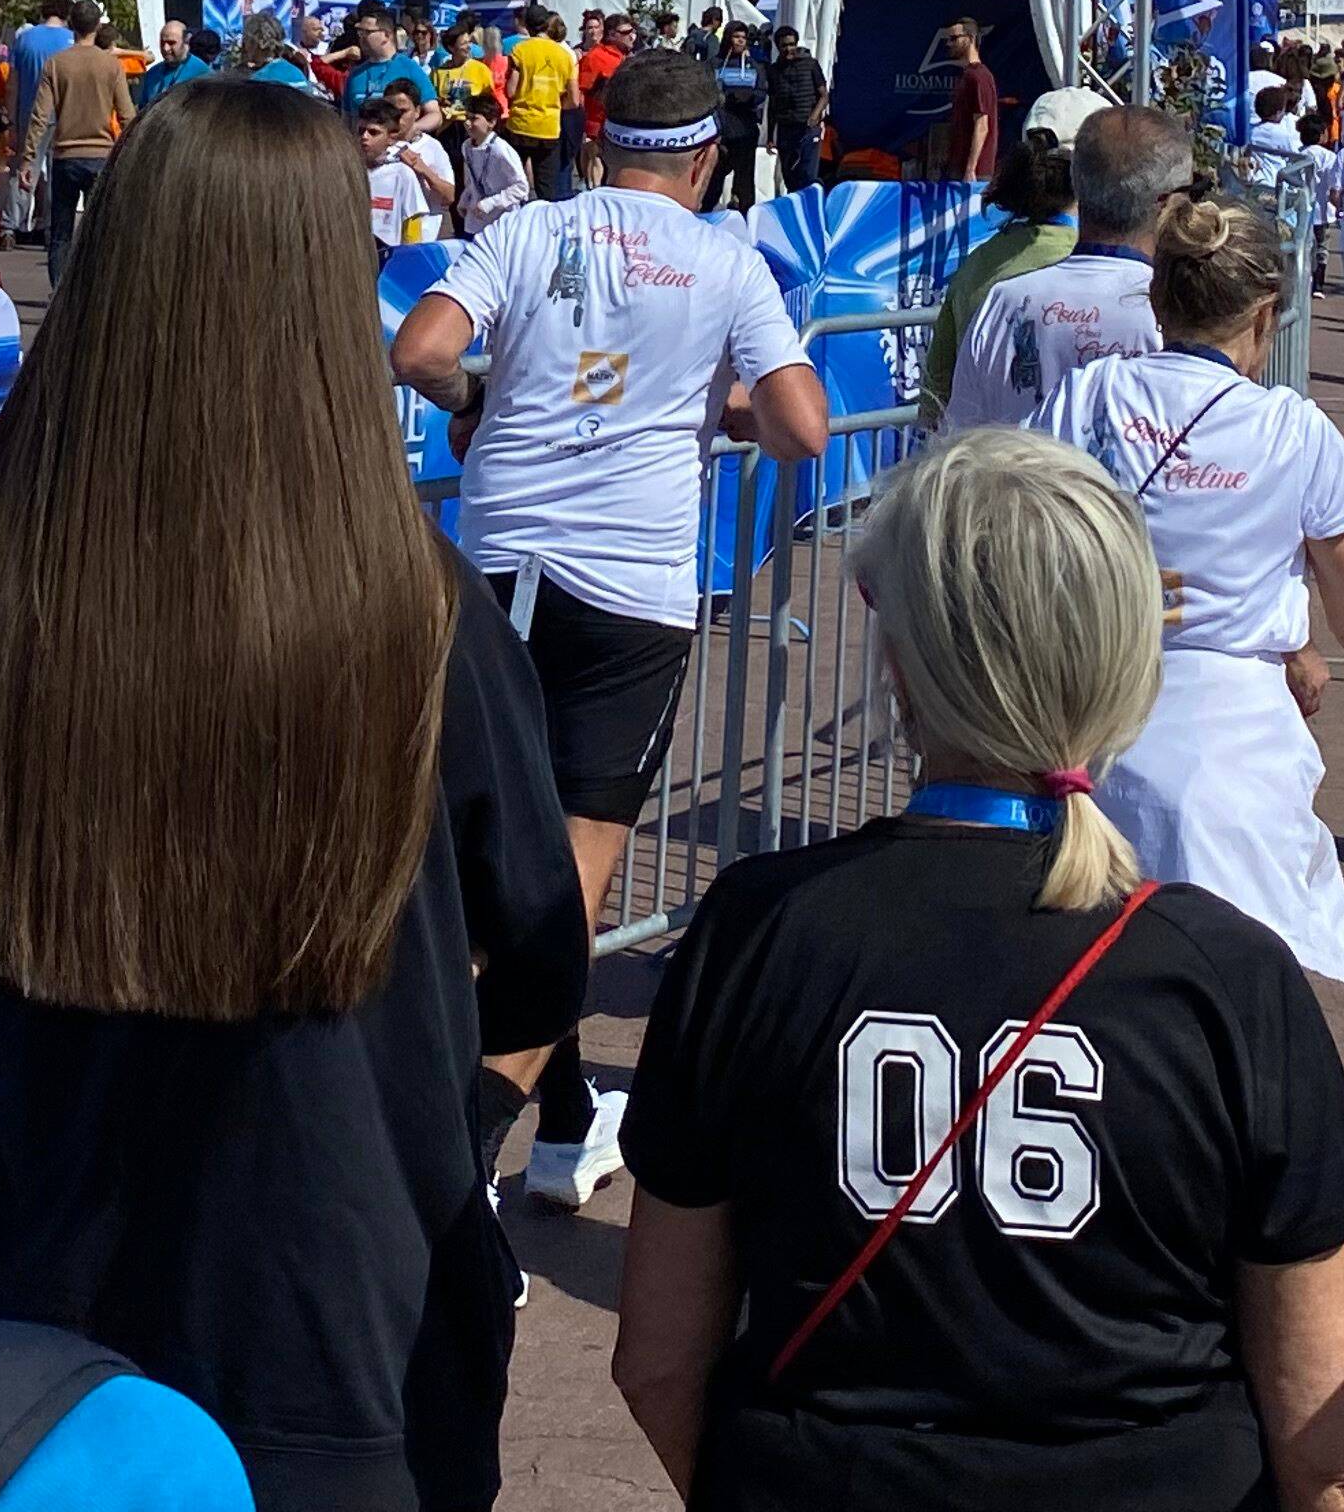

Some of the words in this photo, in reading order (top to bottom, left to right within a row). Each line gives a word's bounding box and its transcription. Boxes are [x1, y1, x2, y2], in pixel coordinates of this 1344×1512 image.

[894, 73, 956, 89] HOMM
[624, 262, 696, 288] Céline
[1163, 462, 1249, 493] Céline
[837, 1010, 1104, 1240] 06
